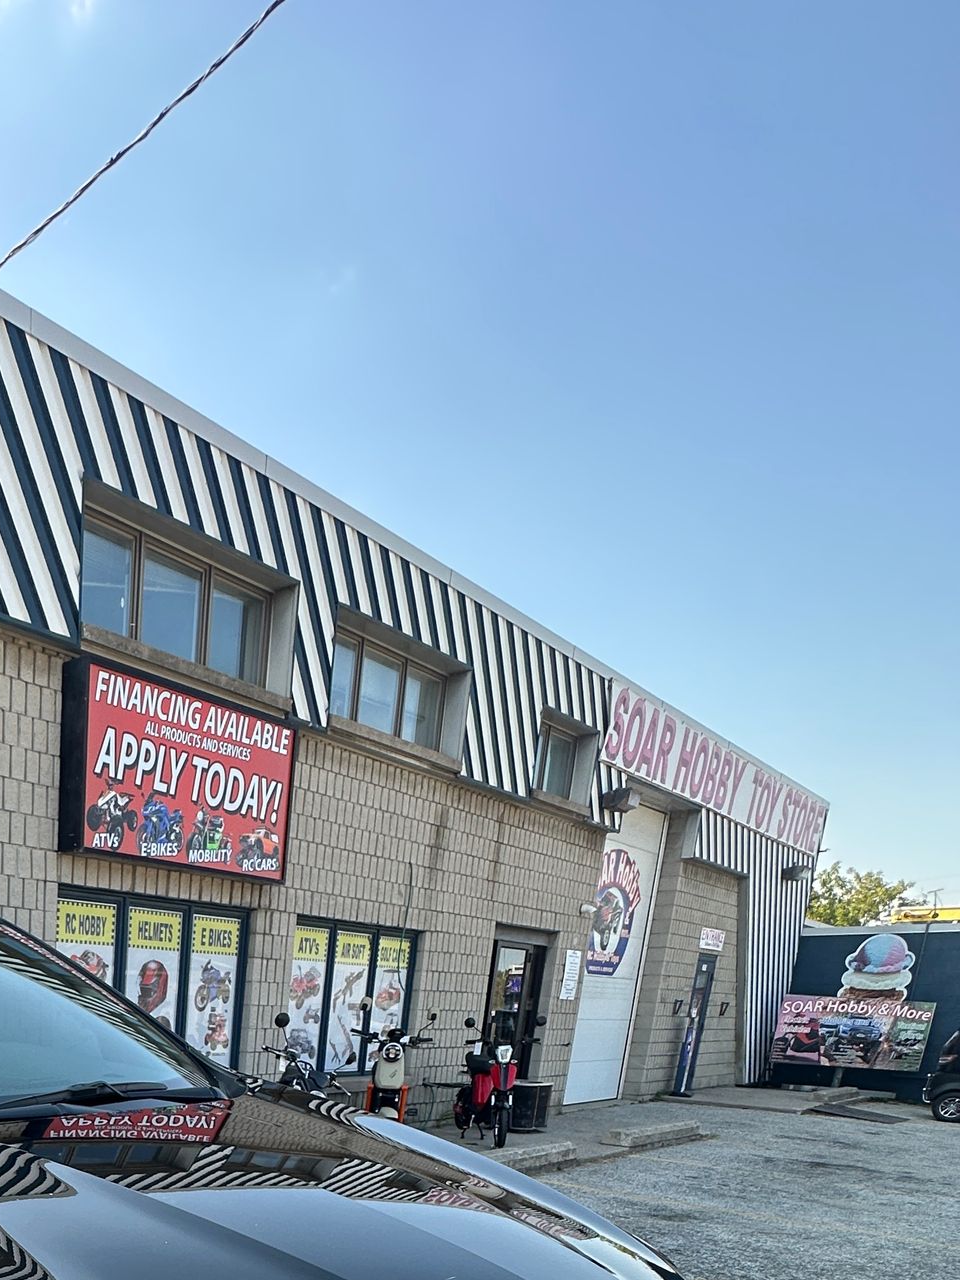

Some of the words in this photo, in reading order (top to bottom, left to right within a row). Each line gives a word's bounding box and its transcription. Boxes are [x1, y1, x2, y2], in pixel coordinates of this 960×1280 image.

[95, 670, 202, 730] FINANCING
[202, 705, 291, 755] AVAILABLE
[145, 720, 159, 736] ALL
[160, 724, 201, 748] PRODUCTS
[201, 737, 218, 753] AND
[218, 742, 251, 762] SERVICES
[93, 726, 189, 797] APPLY
[190, 756, 283, 825] TODAY!
[605, 687, 677, 785] SOAR
[672, 726, 748, 816] HOBBY
[745, 768, 783, 832] TOY
[778, 788, 826, 849] STORE
[92, 832, 119, 849] ATVs
[141, 841, 178, 857] E-BIKES
[189, 848, 232, 863] MOBILITY
[242, 858, 255, 872] RC
[255, 857, 277, 871] CARS
[65, 912, 77, 935] RC
[78, 913, 107, 937] HOBBY
[137, 920, 174, 943] HELMETS
[200, 927, 207, 946] E
[208, 928, 233, 949] BIKES
[297, 936, 320, 956] ATV's
[341, 942, 350, 959] AIR
[351, 943, 366, 960] SOFT
[782, 1000, 824, 1014] SOAR
[825, 1001, 877, 1017] Hobby
[877, 1003, 891, 1016] &
[892, 1004, 932, 1022] More
